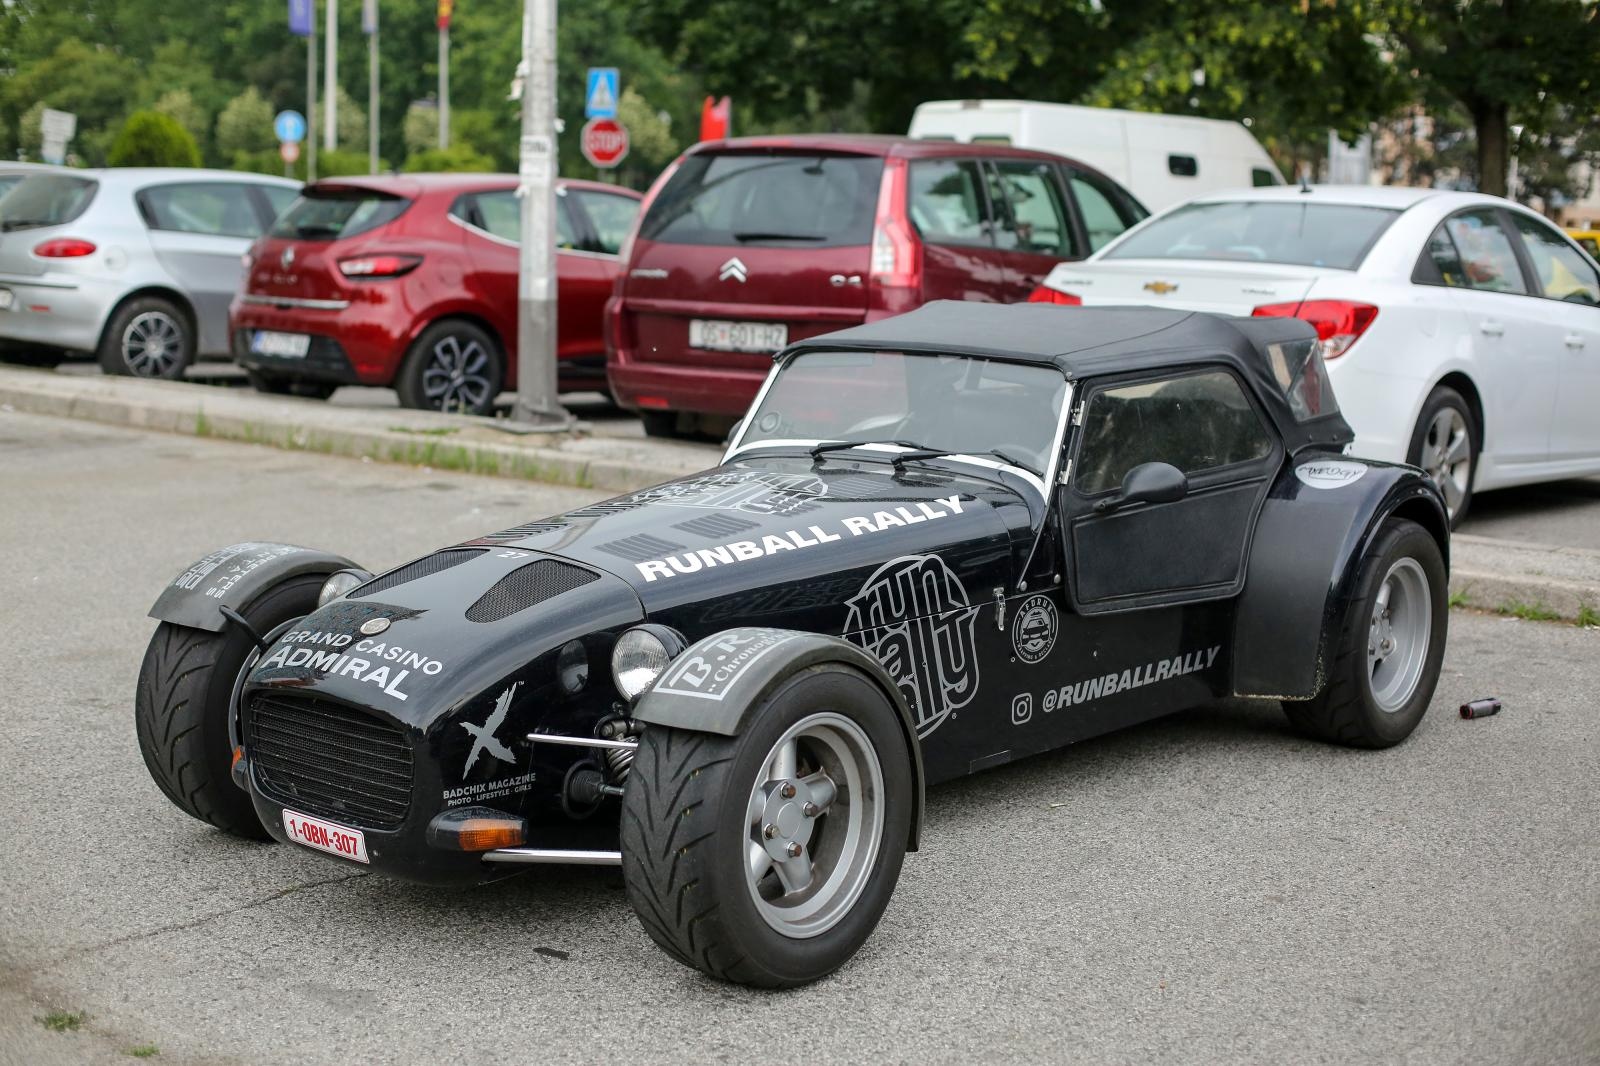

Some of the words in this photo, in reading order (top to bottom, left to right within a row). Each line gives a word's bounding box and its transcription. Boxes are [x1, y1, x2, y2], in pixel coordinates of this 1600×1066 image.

[589, 132, 625, 151] STOP
[634, 525, 841, 583] RUNBALL
[841, 494, 966, 538] RALLY
[260, 645, 410, 701] ADMIRAL
[281, 631, 353, 647] GRAND
[355, 639, 443, 675] CASINO
[1042, 645, 1222, 713] @RUNBALLRALLY
[443, 783, 486, 799] BADCHIX
[488, 773, 536, 791] MAGAZINE
[447, 797, 472, 807] PHOTO
[476, 789, 510, 801] LIFESTYLE
[514, 784, 532, 793] GIRLS
[289, 818, 358, 856] 1-OBN-307
